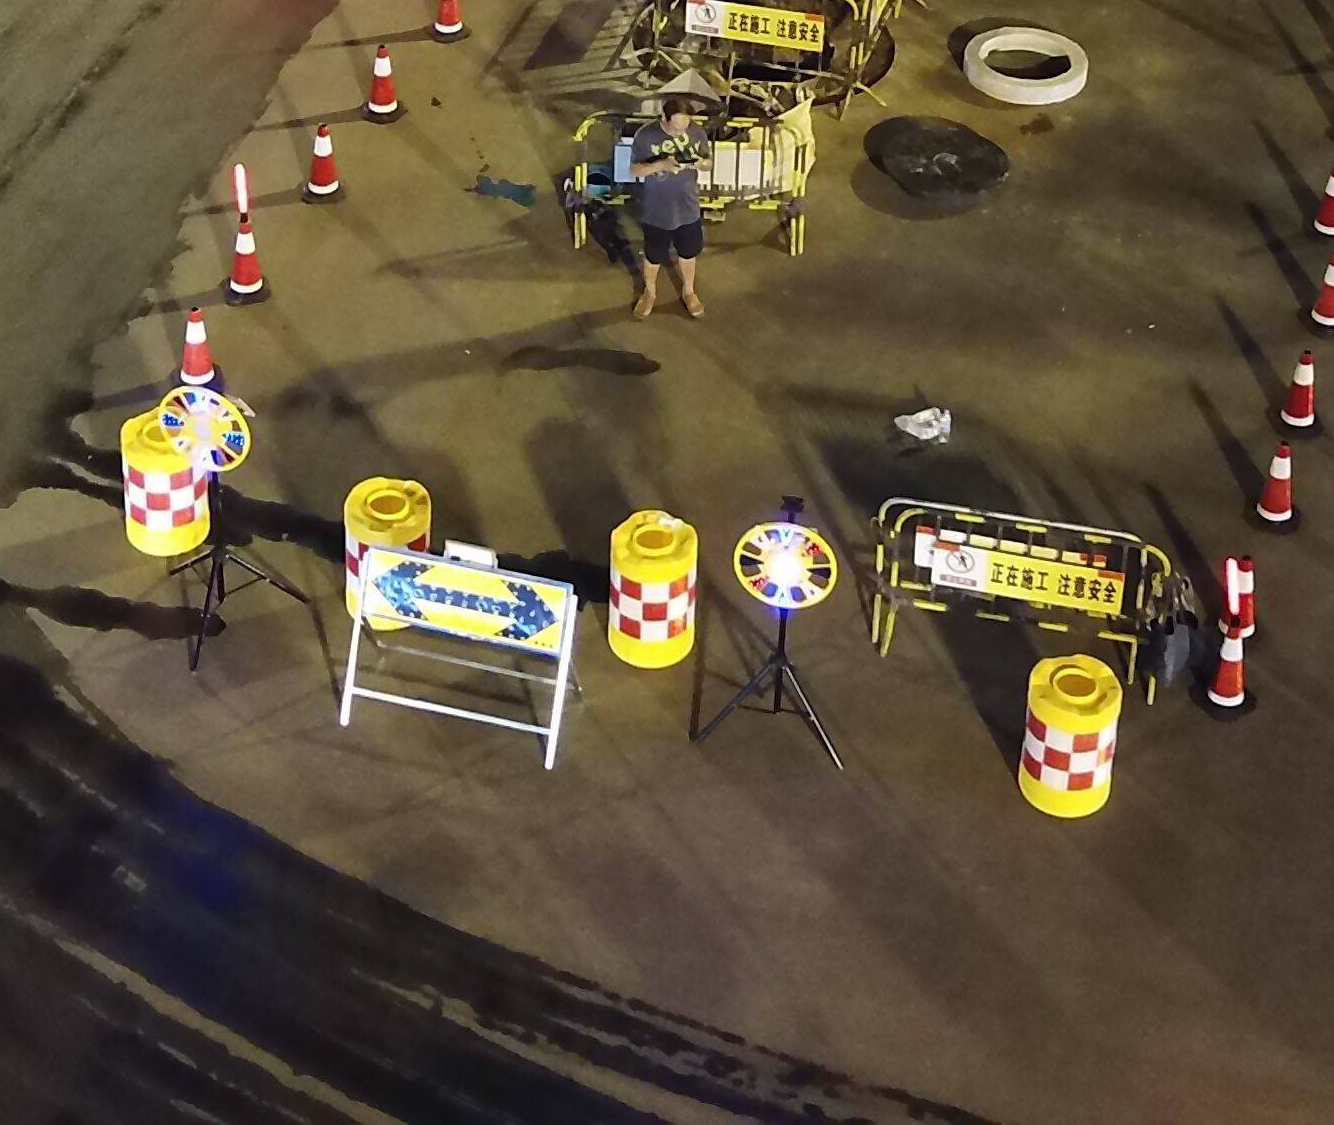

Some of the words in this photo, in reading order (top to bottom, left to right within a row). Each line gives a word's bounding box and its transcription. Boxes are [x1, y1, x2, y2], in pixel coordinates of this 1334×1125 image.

[728, 12, 771, 35] 正在施工
[776, 18, 820, 43] 注意安全
[990, 562, 1049, 591] 正在施工
[1058, 573, 1118, 604] 注意安全
